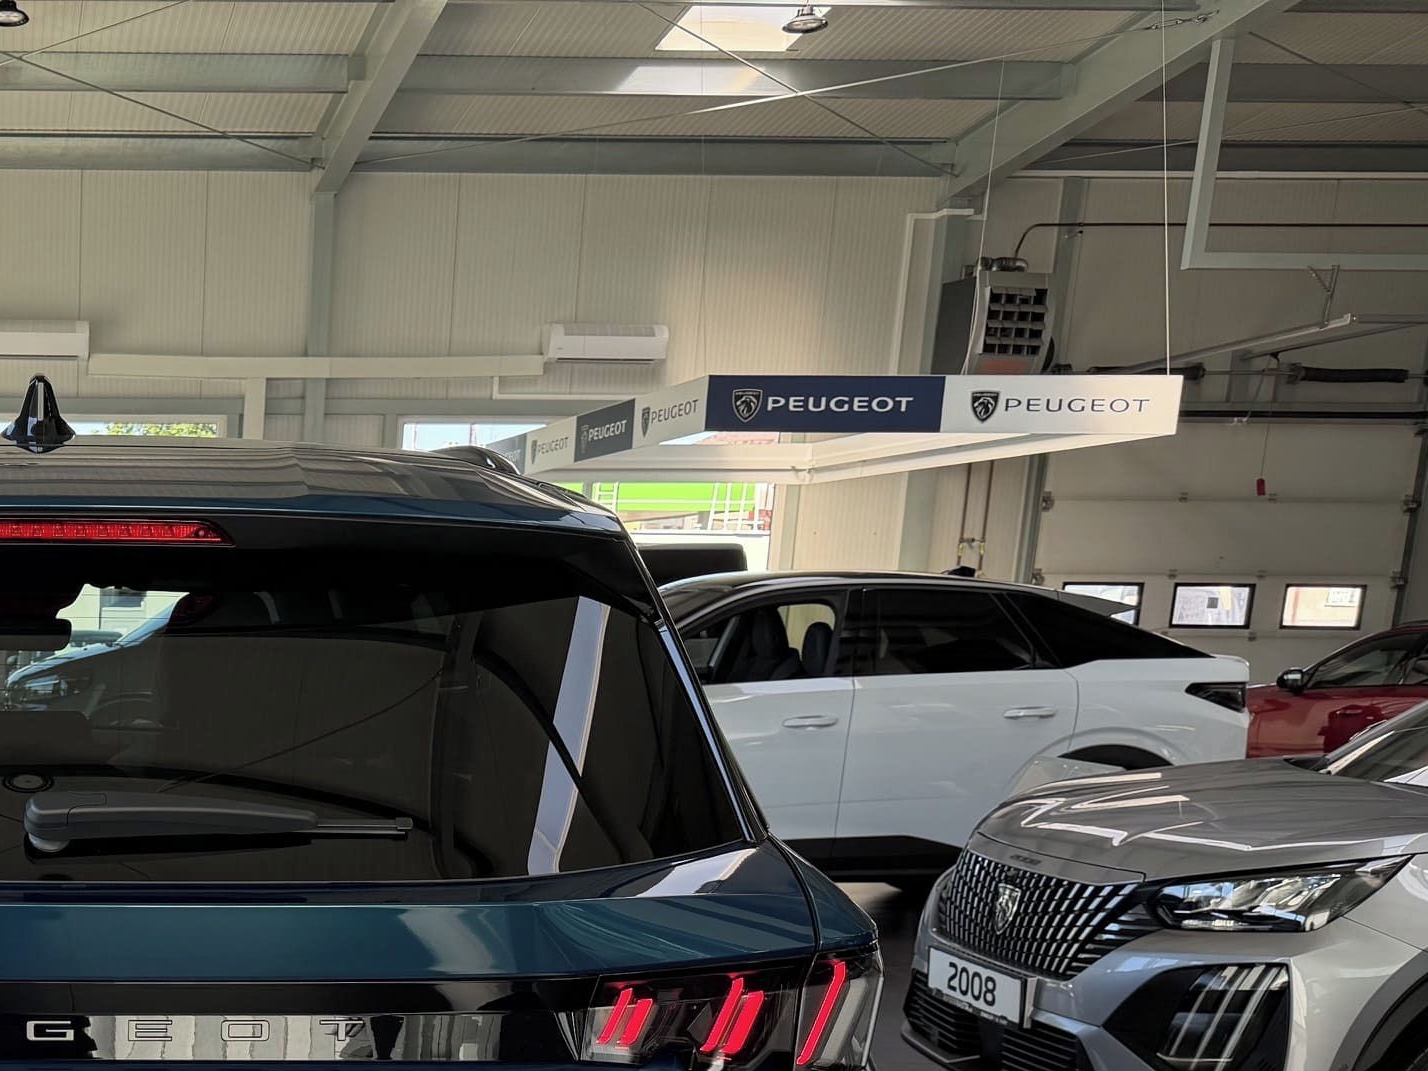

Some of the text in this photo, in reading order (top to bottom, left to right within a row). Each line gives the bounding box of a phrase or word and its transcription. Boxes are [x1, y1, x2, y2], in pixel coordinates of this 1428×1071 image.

[651, 399, 699, 424] PEUGEOT
[767, 396, 914, 413] PEUGEOT
[1004, 397, 1150, 413] PEUGEOT
[588, 419, 628, 442] PEUGEOT
[537, 436, 569, 455] PEUGEOT
[947, 961, 997, 1007] 2008
